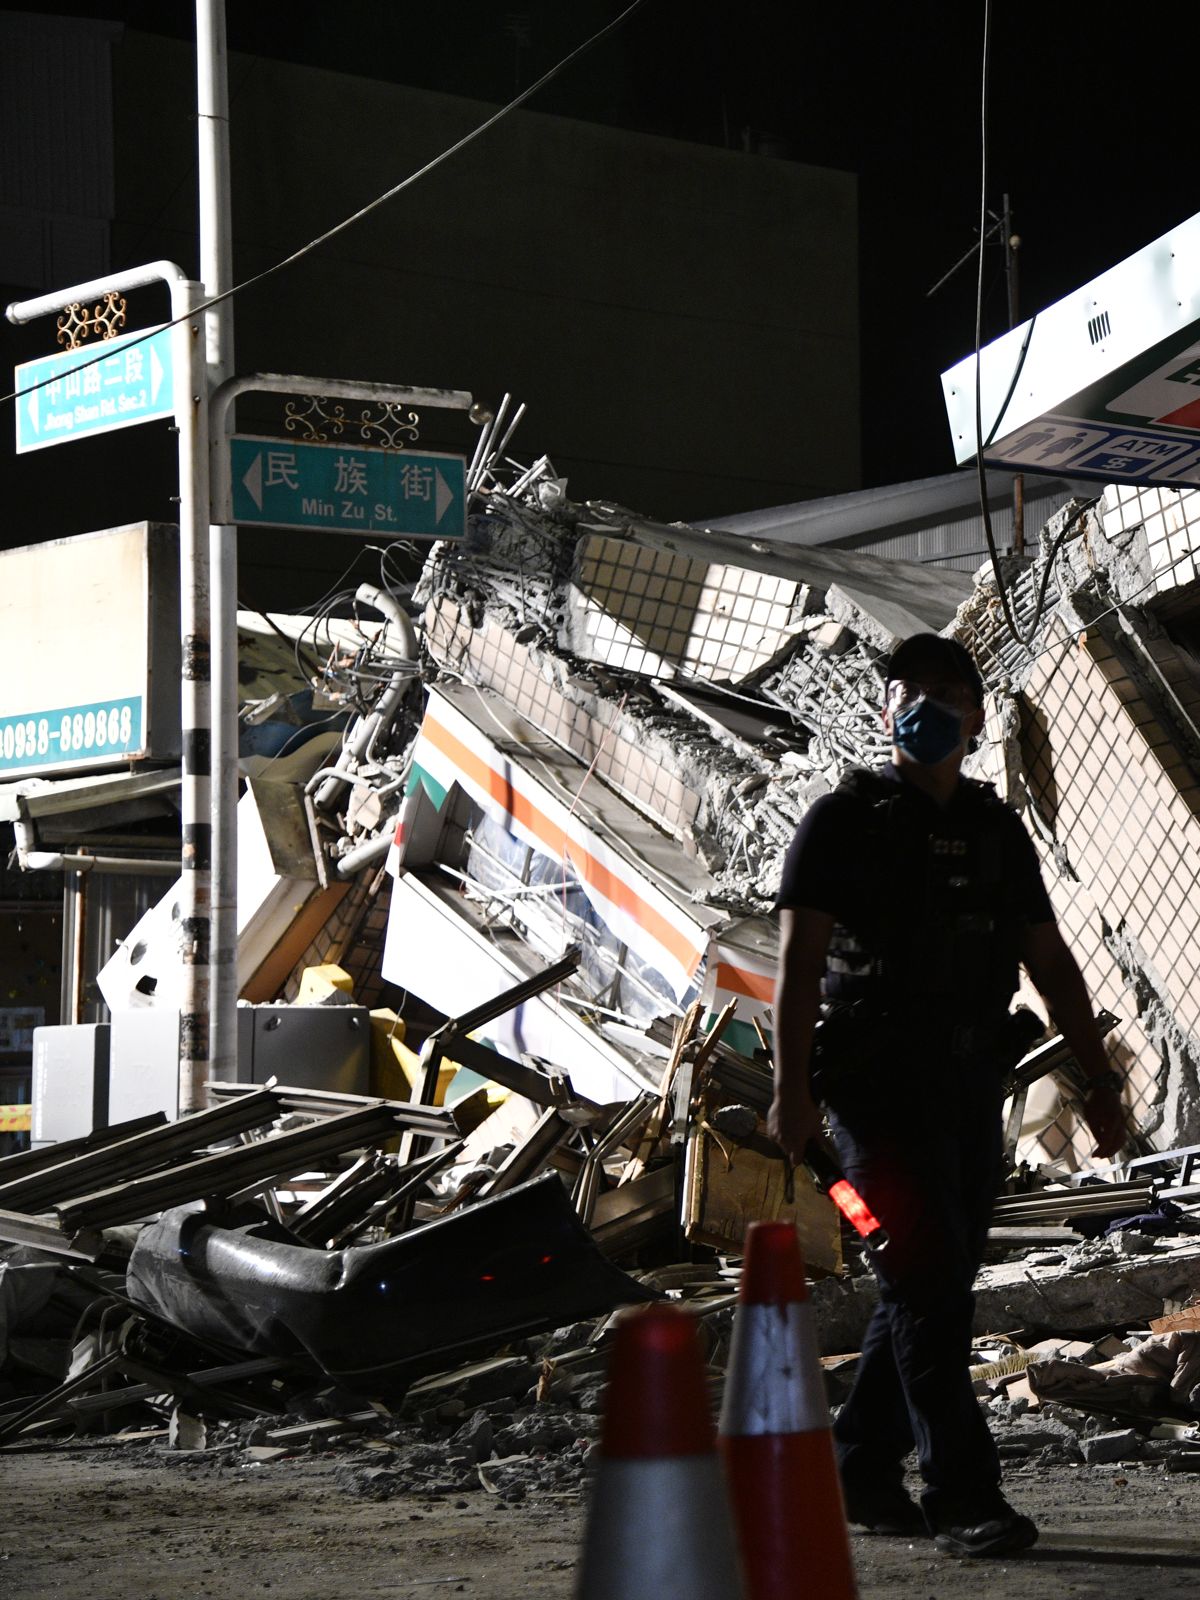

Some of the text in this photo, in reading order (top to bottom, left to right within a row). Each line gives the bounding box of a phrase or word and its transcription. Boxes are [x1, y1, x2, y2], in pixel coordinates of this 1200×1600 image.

[45, 348, 144, 406] 中山路二段
[74, 403, 99, 423] Shan
[100, 398, 116, 417] Rd.
[1111, 439, 1181, 457] ATM
[264, 451, 433, 501] 民族街
[302, 498, 398, 522] Min Zu St.
[3, 706, 132, 760] 0938-889868
